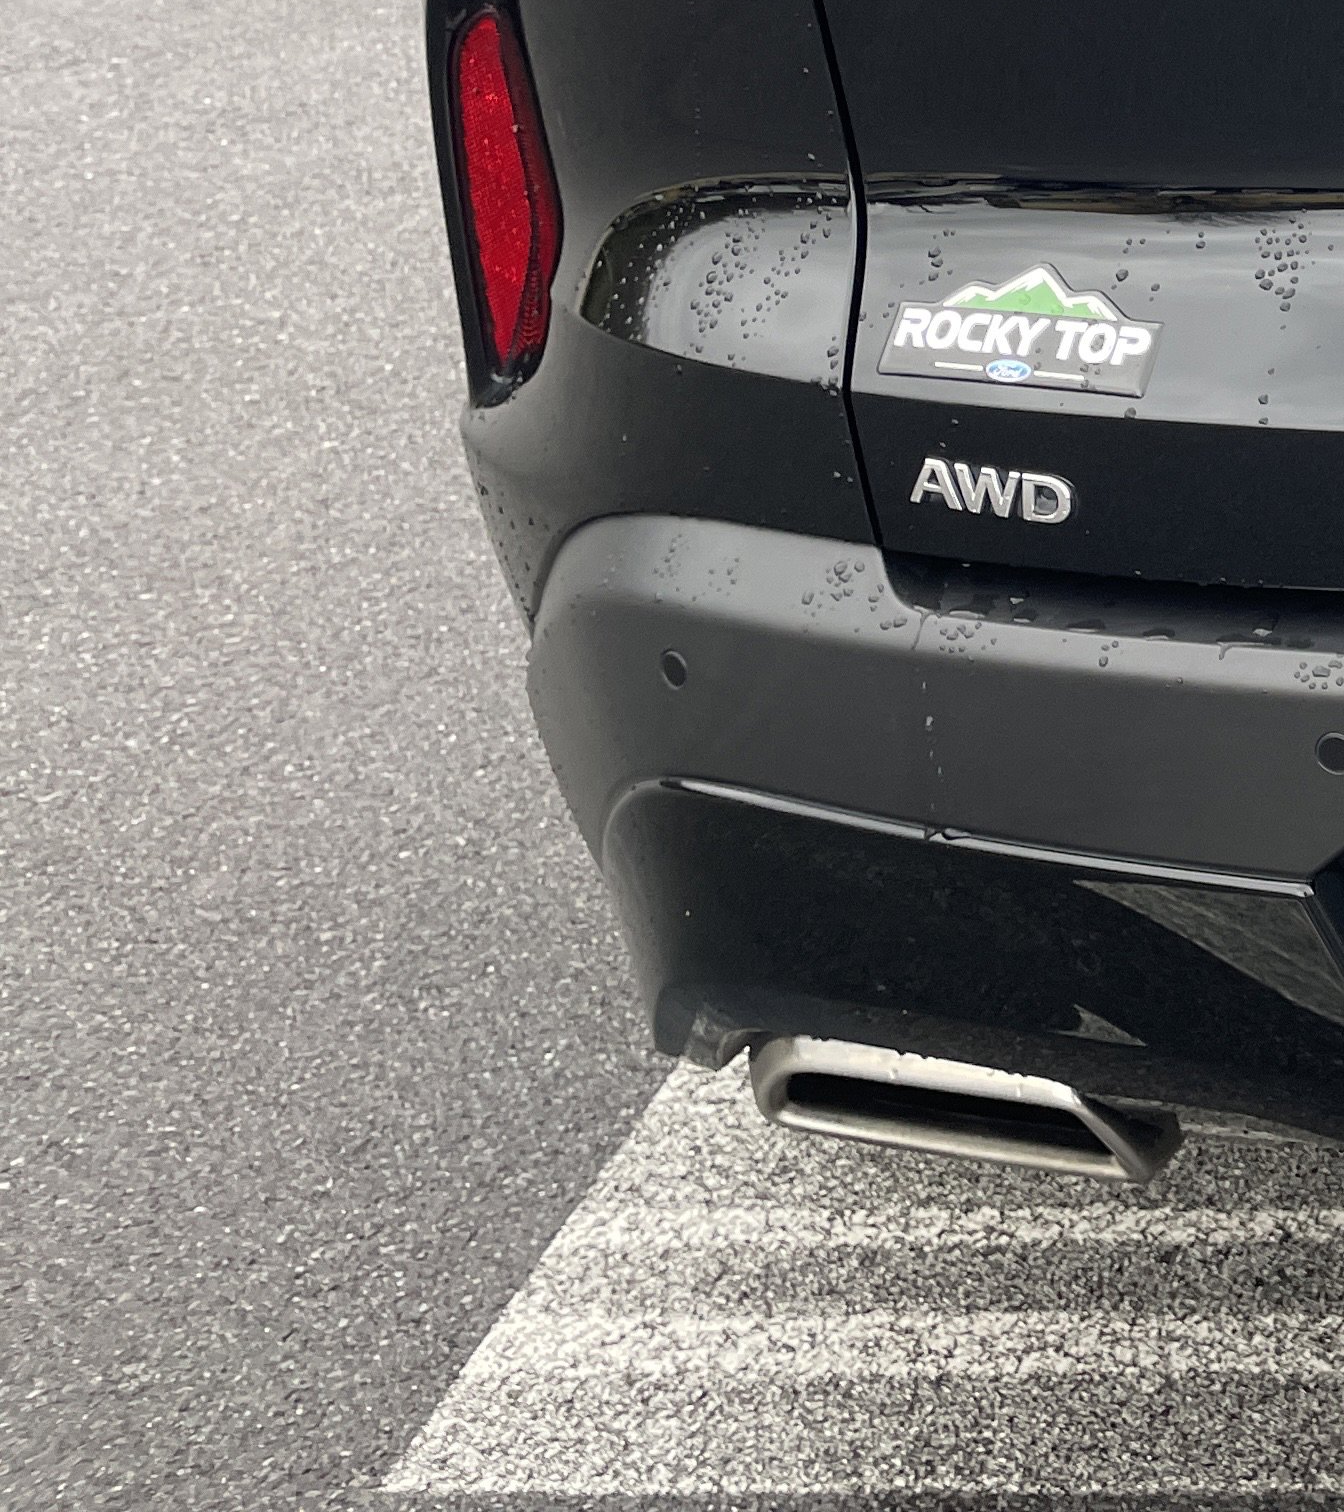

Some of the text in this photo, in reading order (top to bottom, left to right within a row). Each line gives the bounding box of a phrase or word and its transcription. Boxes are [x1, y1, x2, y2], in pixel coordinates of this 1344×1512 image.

[894, 308, 1152, 366] ROCKY TOP
[909, 457, 1073, 524] AWD
